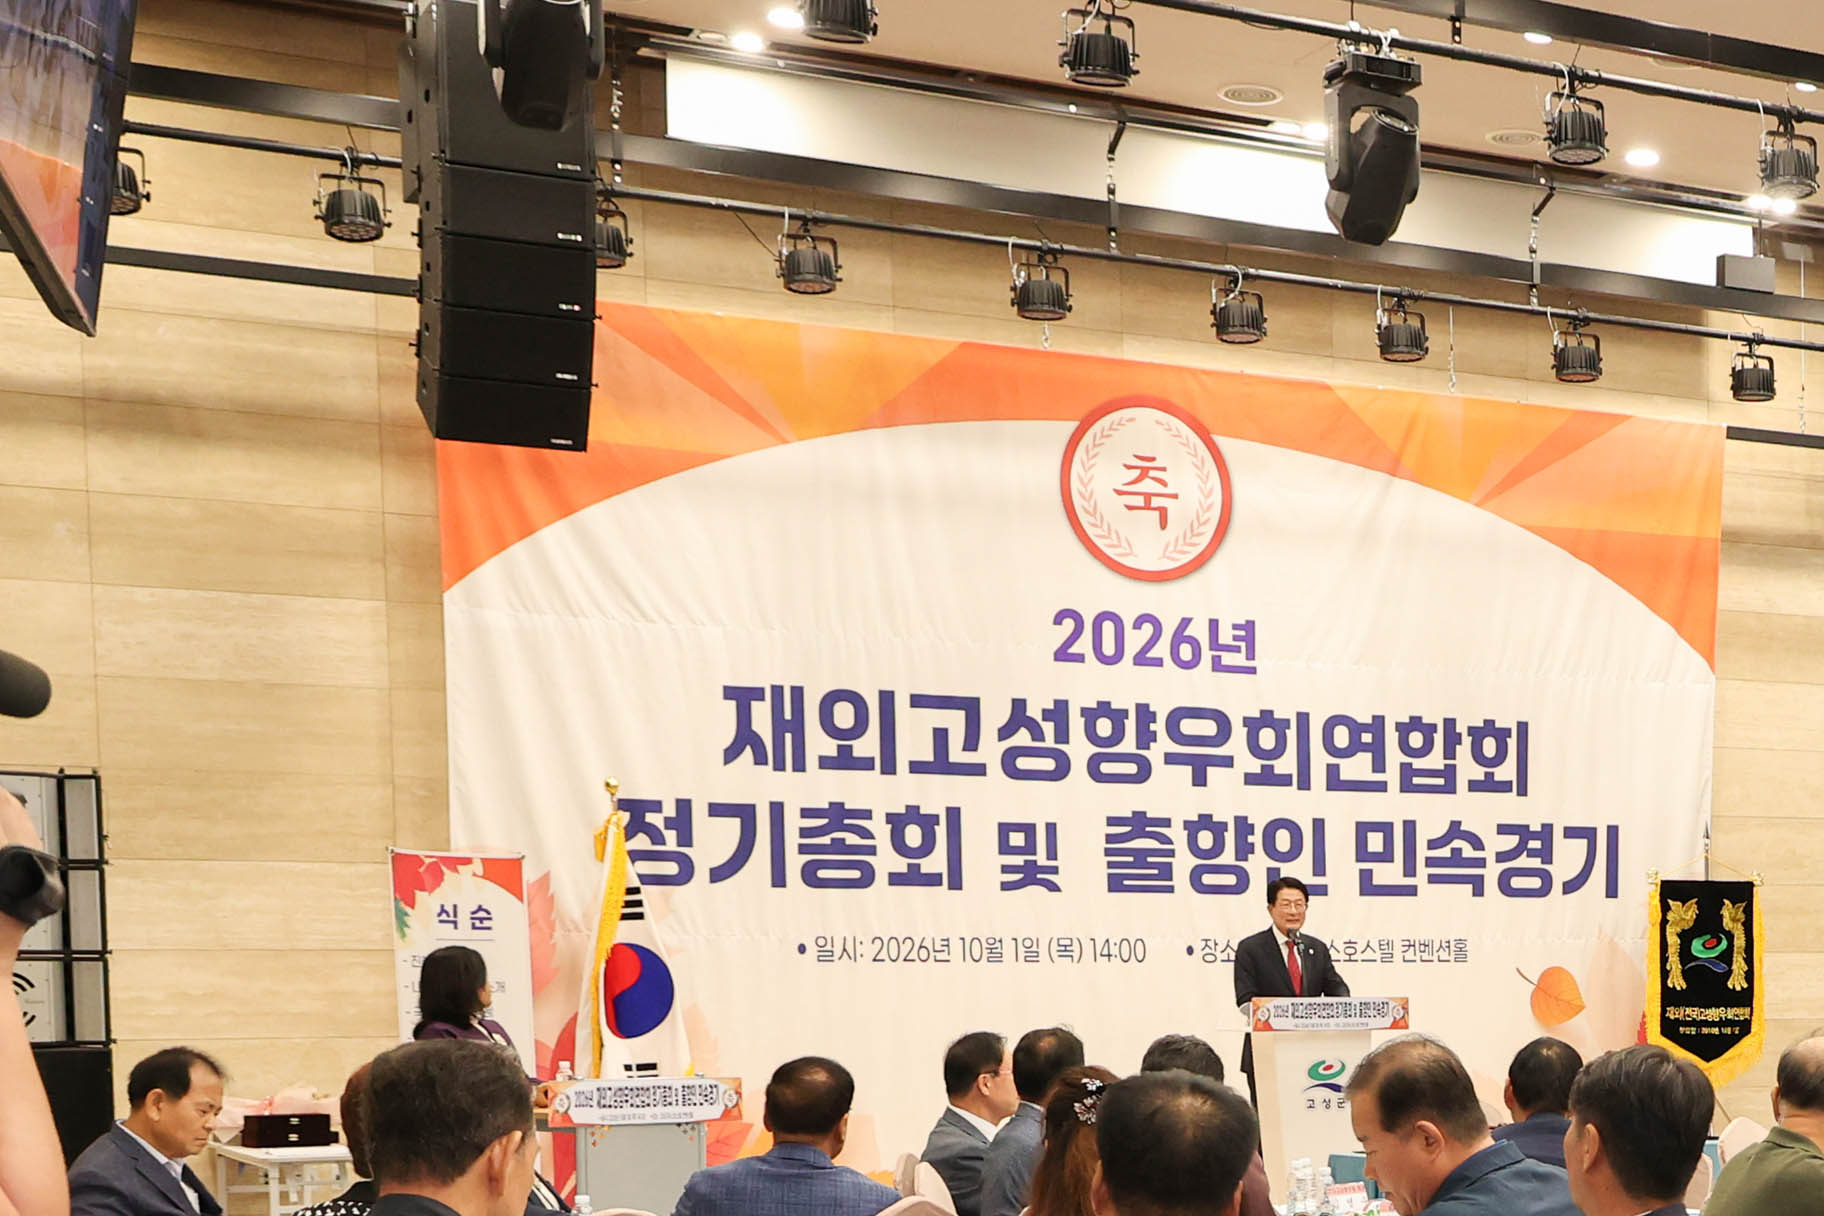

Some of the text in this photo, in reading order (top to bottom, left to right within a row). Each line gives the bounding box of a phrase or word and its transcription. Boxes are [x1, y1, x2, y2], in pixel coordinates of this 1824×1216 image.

[1112, 453, 1180, 531] 축
[1052, 607, 1257, 675] 2026년
[721, 683, 1530, 797] 재외고성향우회연합회
[617, 797, 1620, 899] 정기총회 및 출향인 민속경기
[871, 935, 950, 963] 2026년
[958, 936, 1004, 963] 10월
[1010, 936, 1041, 963] 1일
[1047, 936, 1084, 964] (목)
[1089, 936, 1148, 963] 14:00
[1400, 938, 1469, 964] 컨벤션홀
